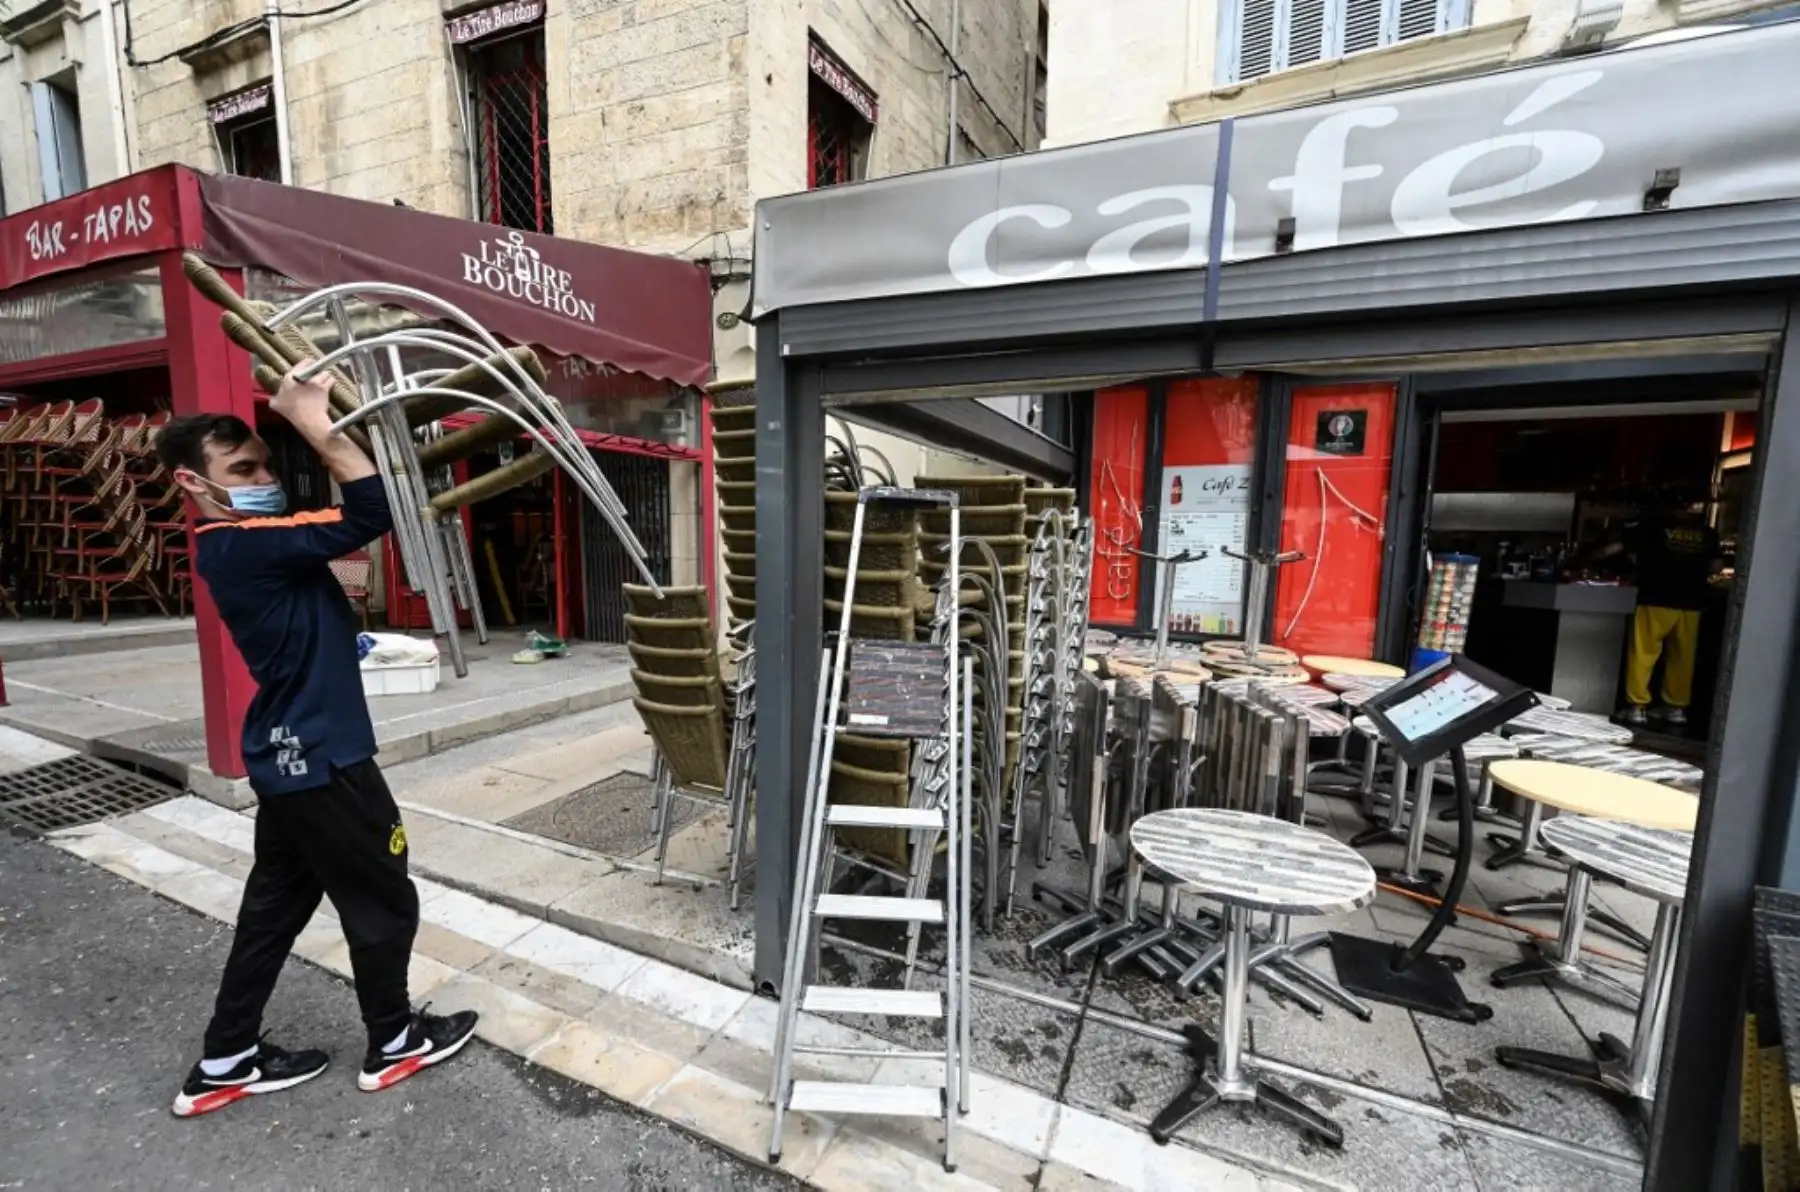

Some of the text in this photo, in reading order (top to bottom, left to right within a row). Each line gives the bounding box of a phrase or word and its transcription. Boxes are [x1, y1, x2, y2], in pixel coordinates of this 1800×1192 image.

[948, 71, 1605, 286] café
[25, 219, 66, 260] BAR
[83, 194, 153, 244] TAPAS
[480, 239, 509, 271] LE
[460, 252, 596, 323] BOUCHON
